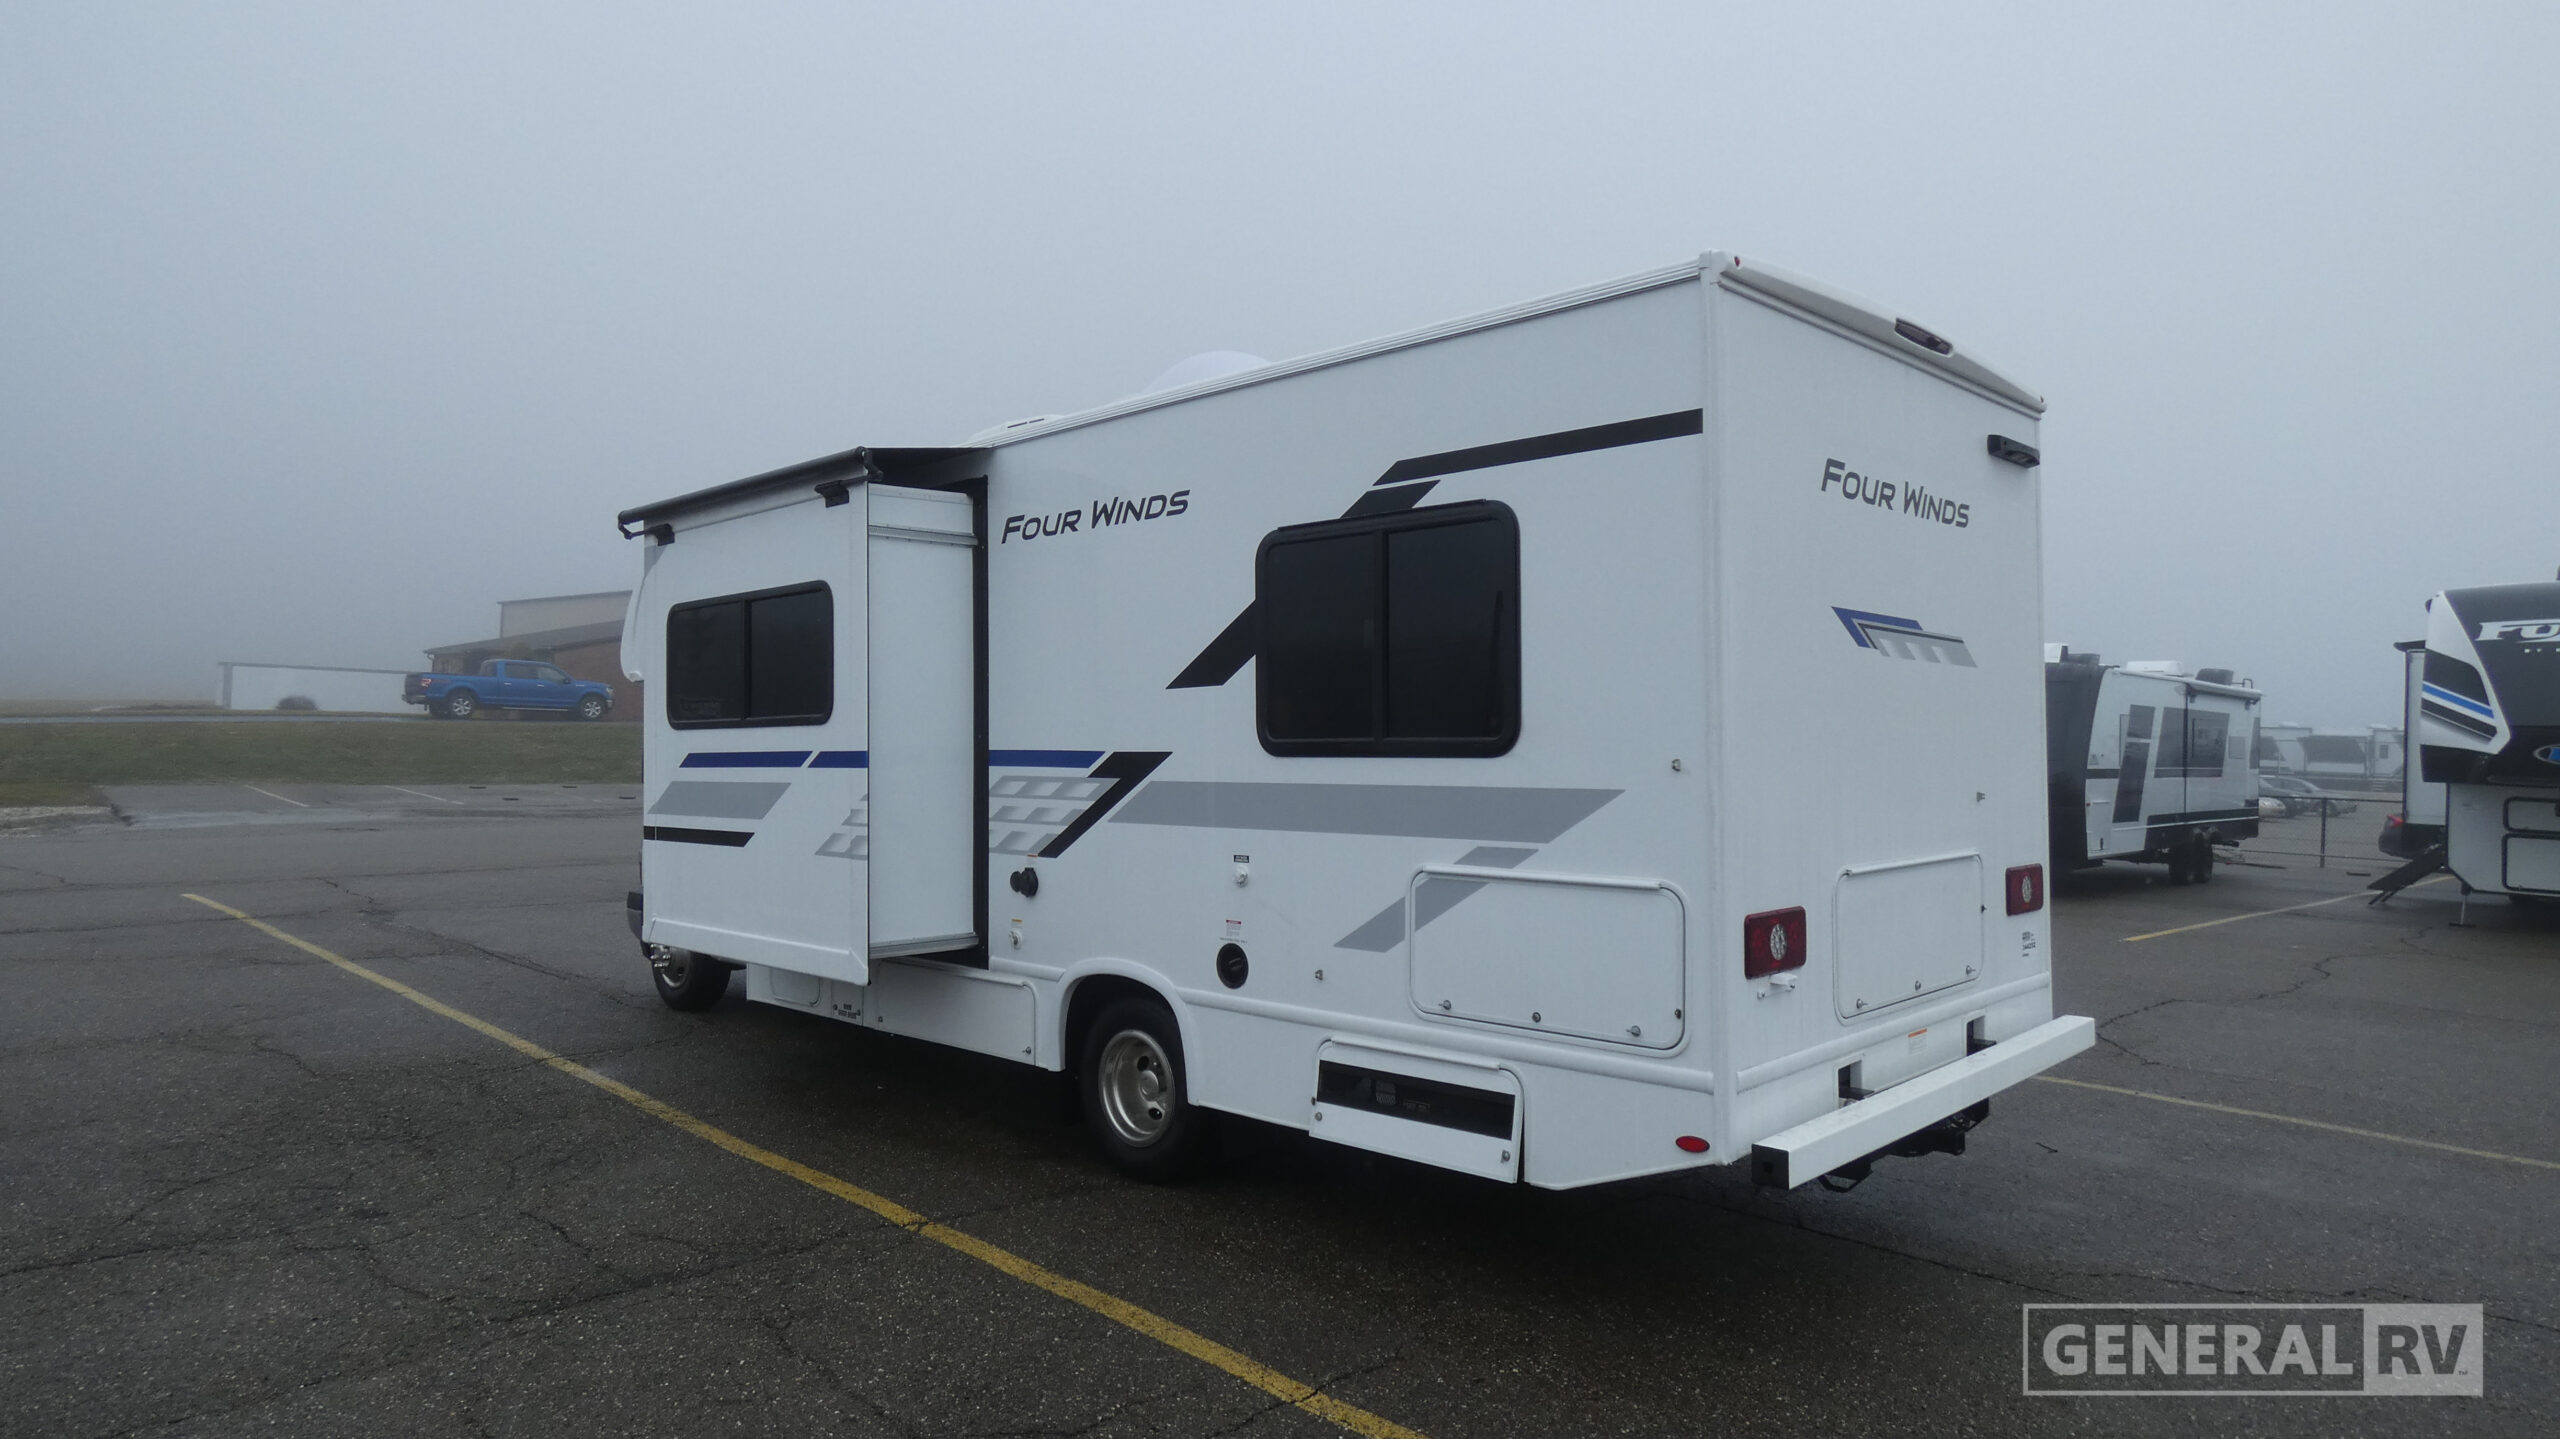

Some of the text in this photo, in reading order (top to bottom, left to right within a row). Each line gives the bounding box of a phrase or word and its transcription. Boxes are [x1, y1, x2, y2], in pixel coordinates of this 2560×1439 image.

[1001, 489, 1190, 544] FOUR WINDS
[1821, 458, 1970, 528] FOUR WINDS
